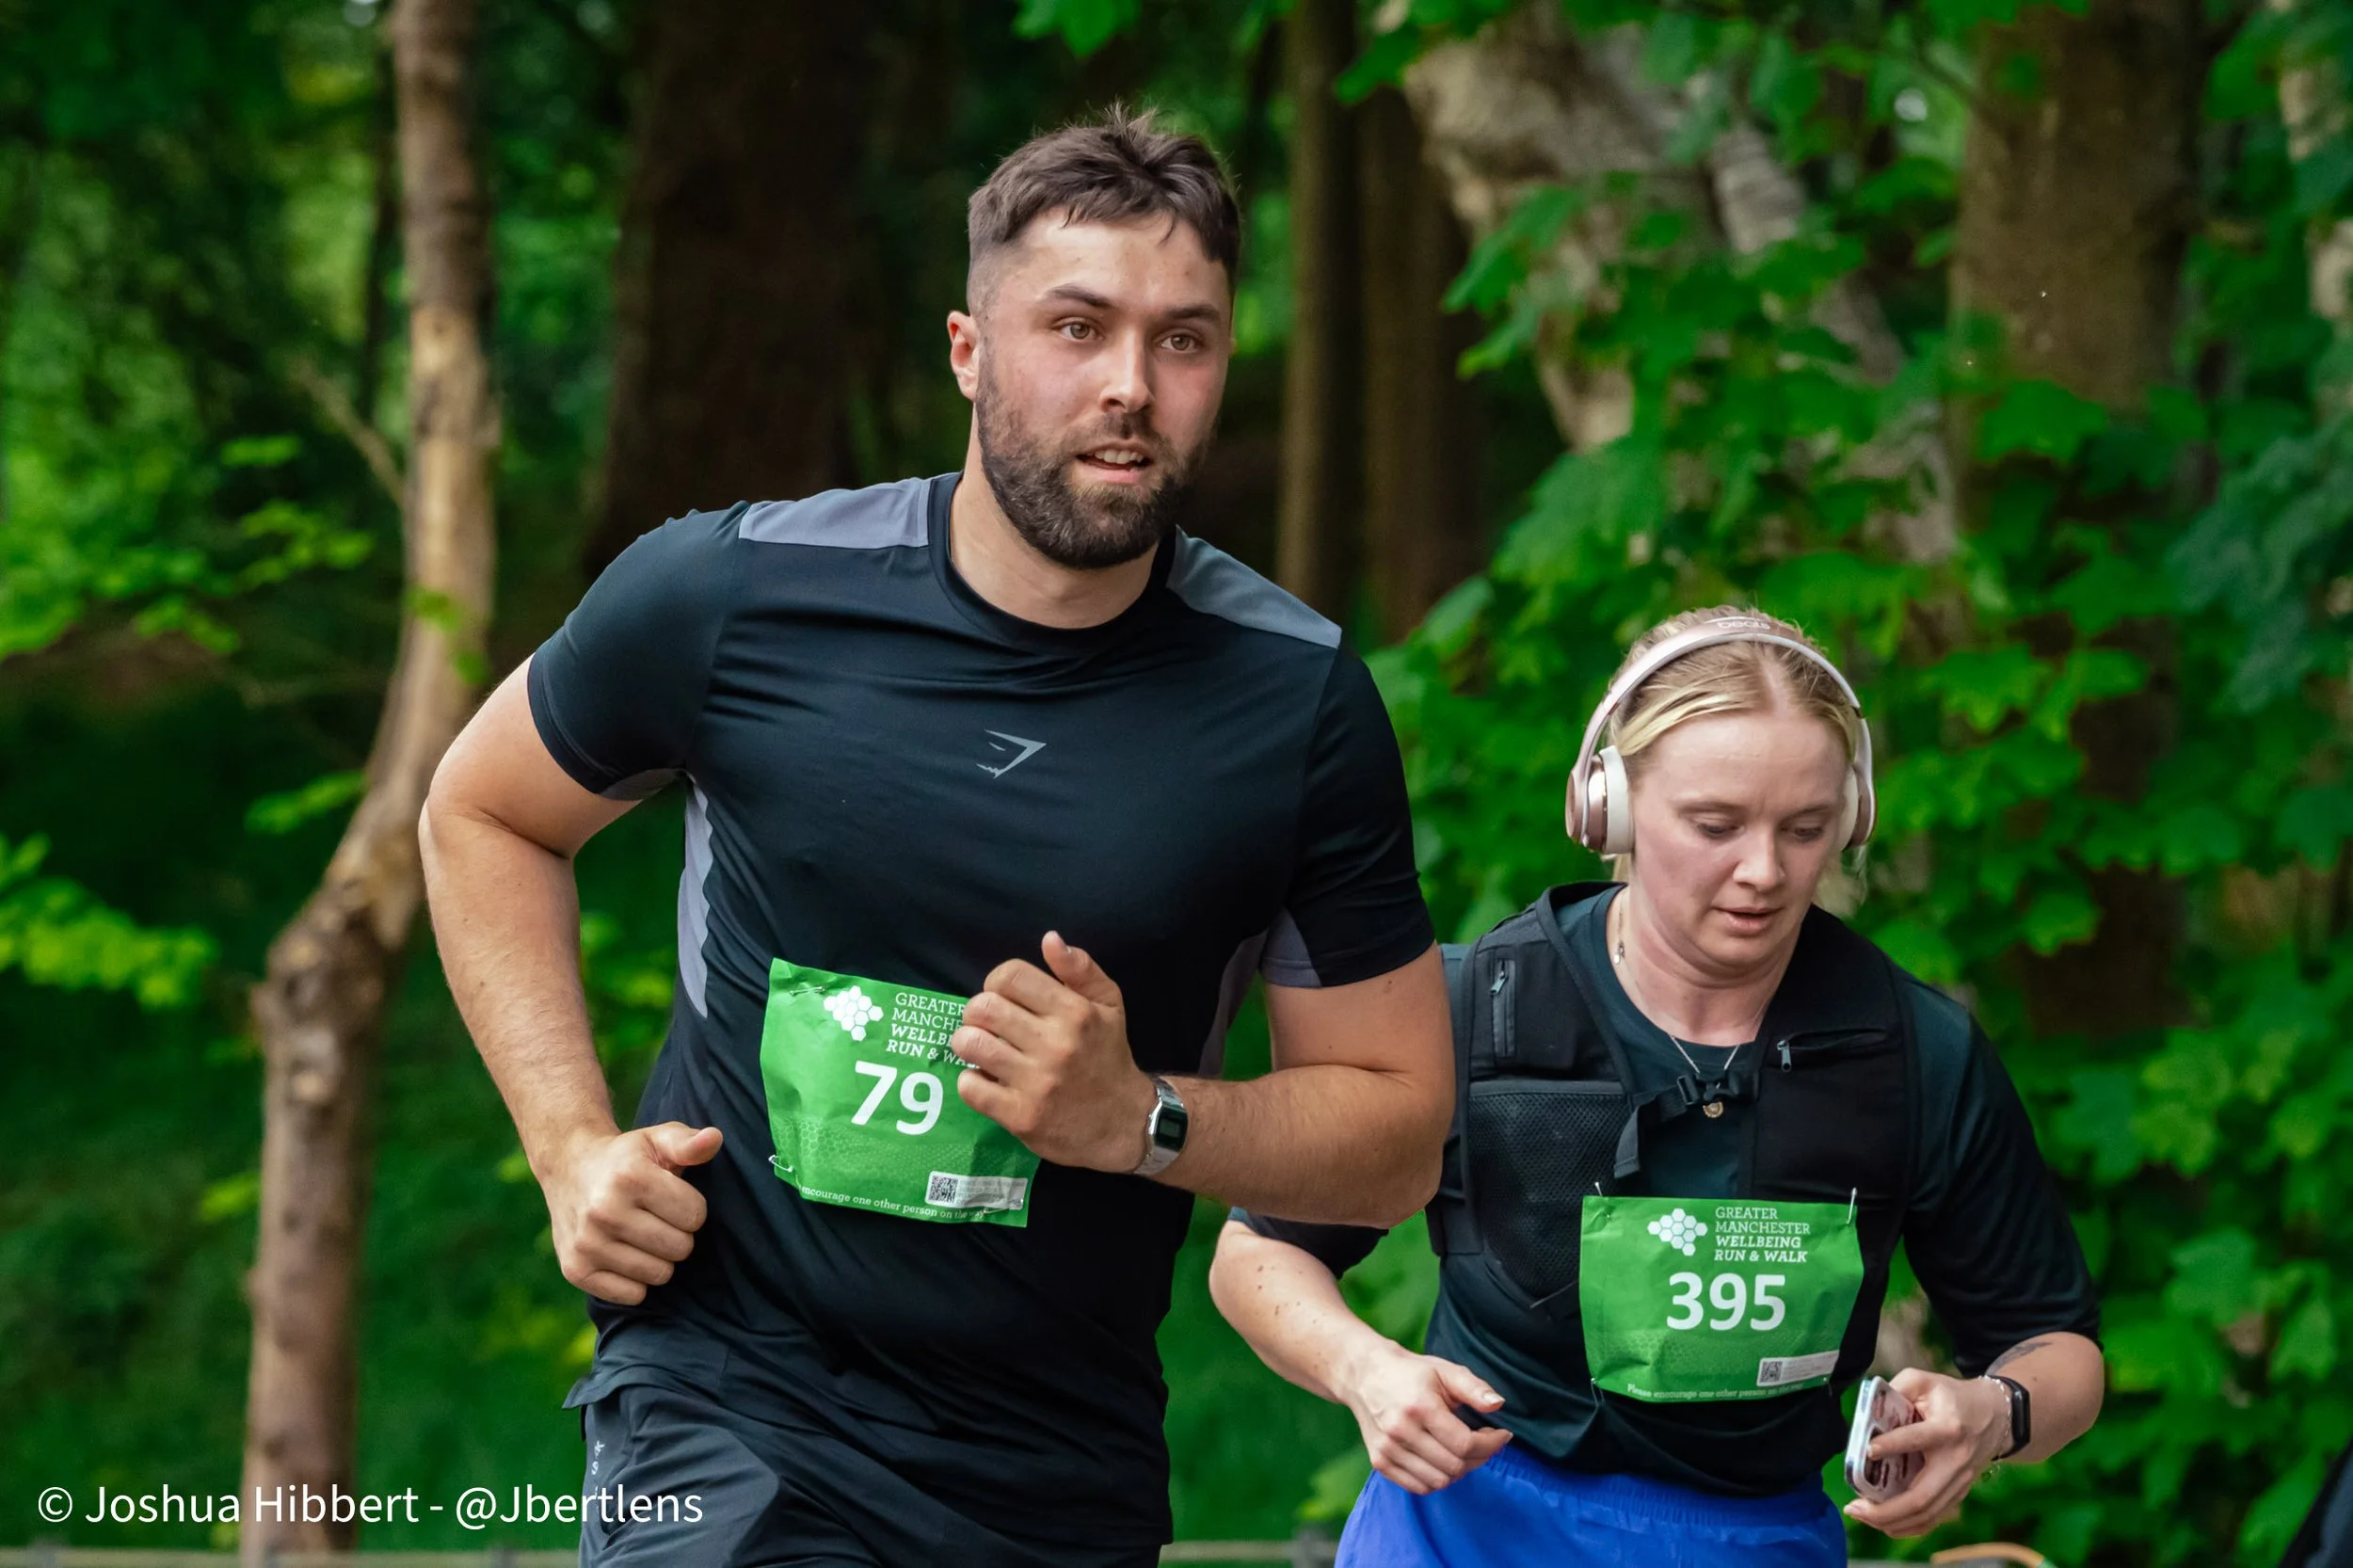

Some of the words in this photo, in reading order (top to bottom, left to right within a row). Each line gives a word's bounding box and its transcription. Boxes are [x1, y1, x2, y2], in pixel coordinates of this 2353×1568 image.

[895, 992, 966, 1016] GREATER
[891, 1007, 965, 1031] MANCHE
[886, 1039, 925, 1058] RUN
[927, 1048, 939, 1060] &
[851, 1060, 943, 1136] 79
[853, 1196, 872, 1206] one
[873, 1198, 901, 1210] other
[903, 1205, 937, 1217] person
[939, 1210, 952, 1219] on
[1715, 1206, 1779, 1220] GREATER
[1715, 1221, 1811, 1235] MANCHESTER
[1716, 1235, 1801, 1248] WELLBEING
[1714, 1249, 1747, 1261] RUN
[1749, 1250, 1760, 1262] &
[1764, 1250, 1808, 1263] WALK
[1666, 1272, 1785, 1331] 395
